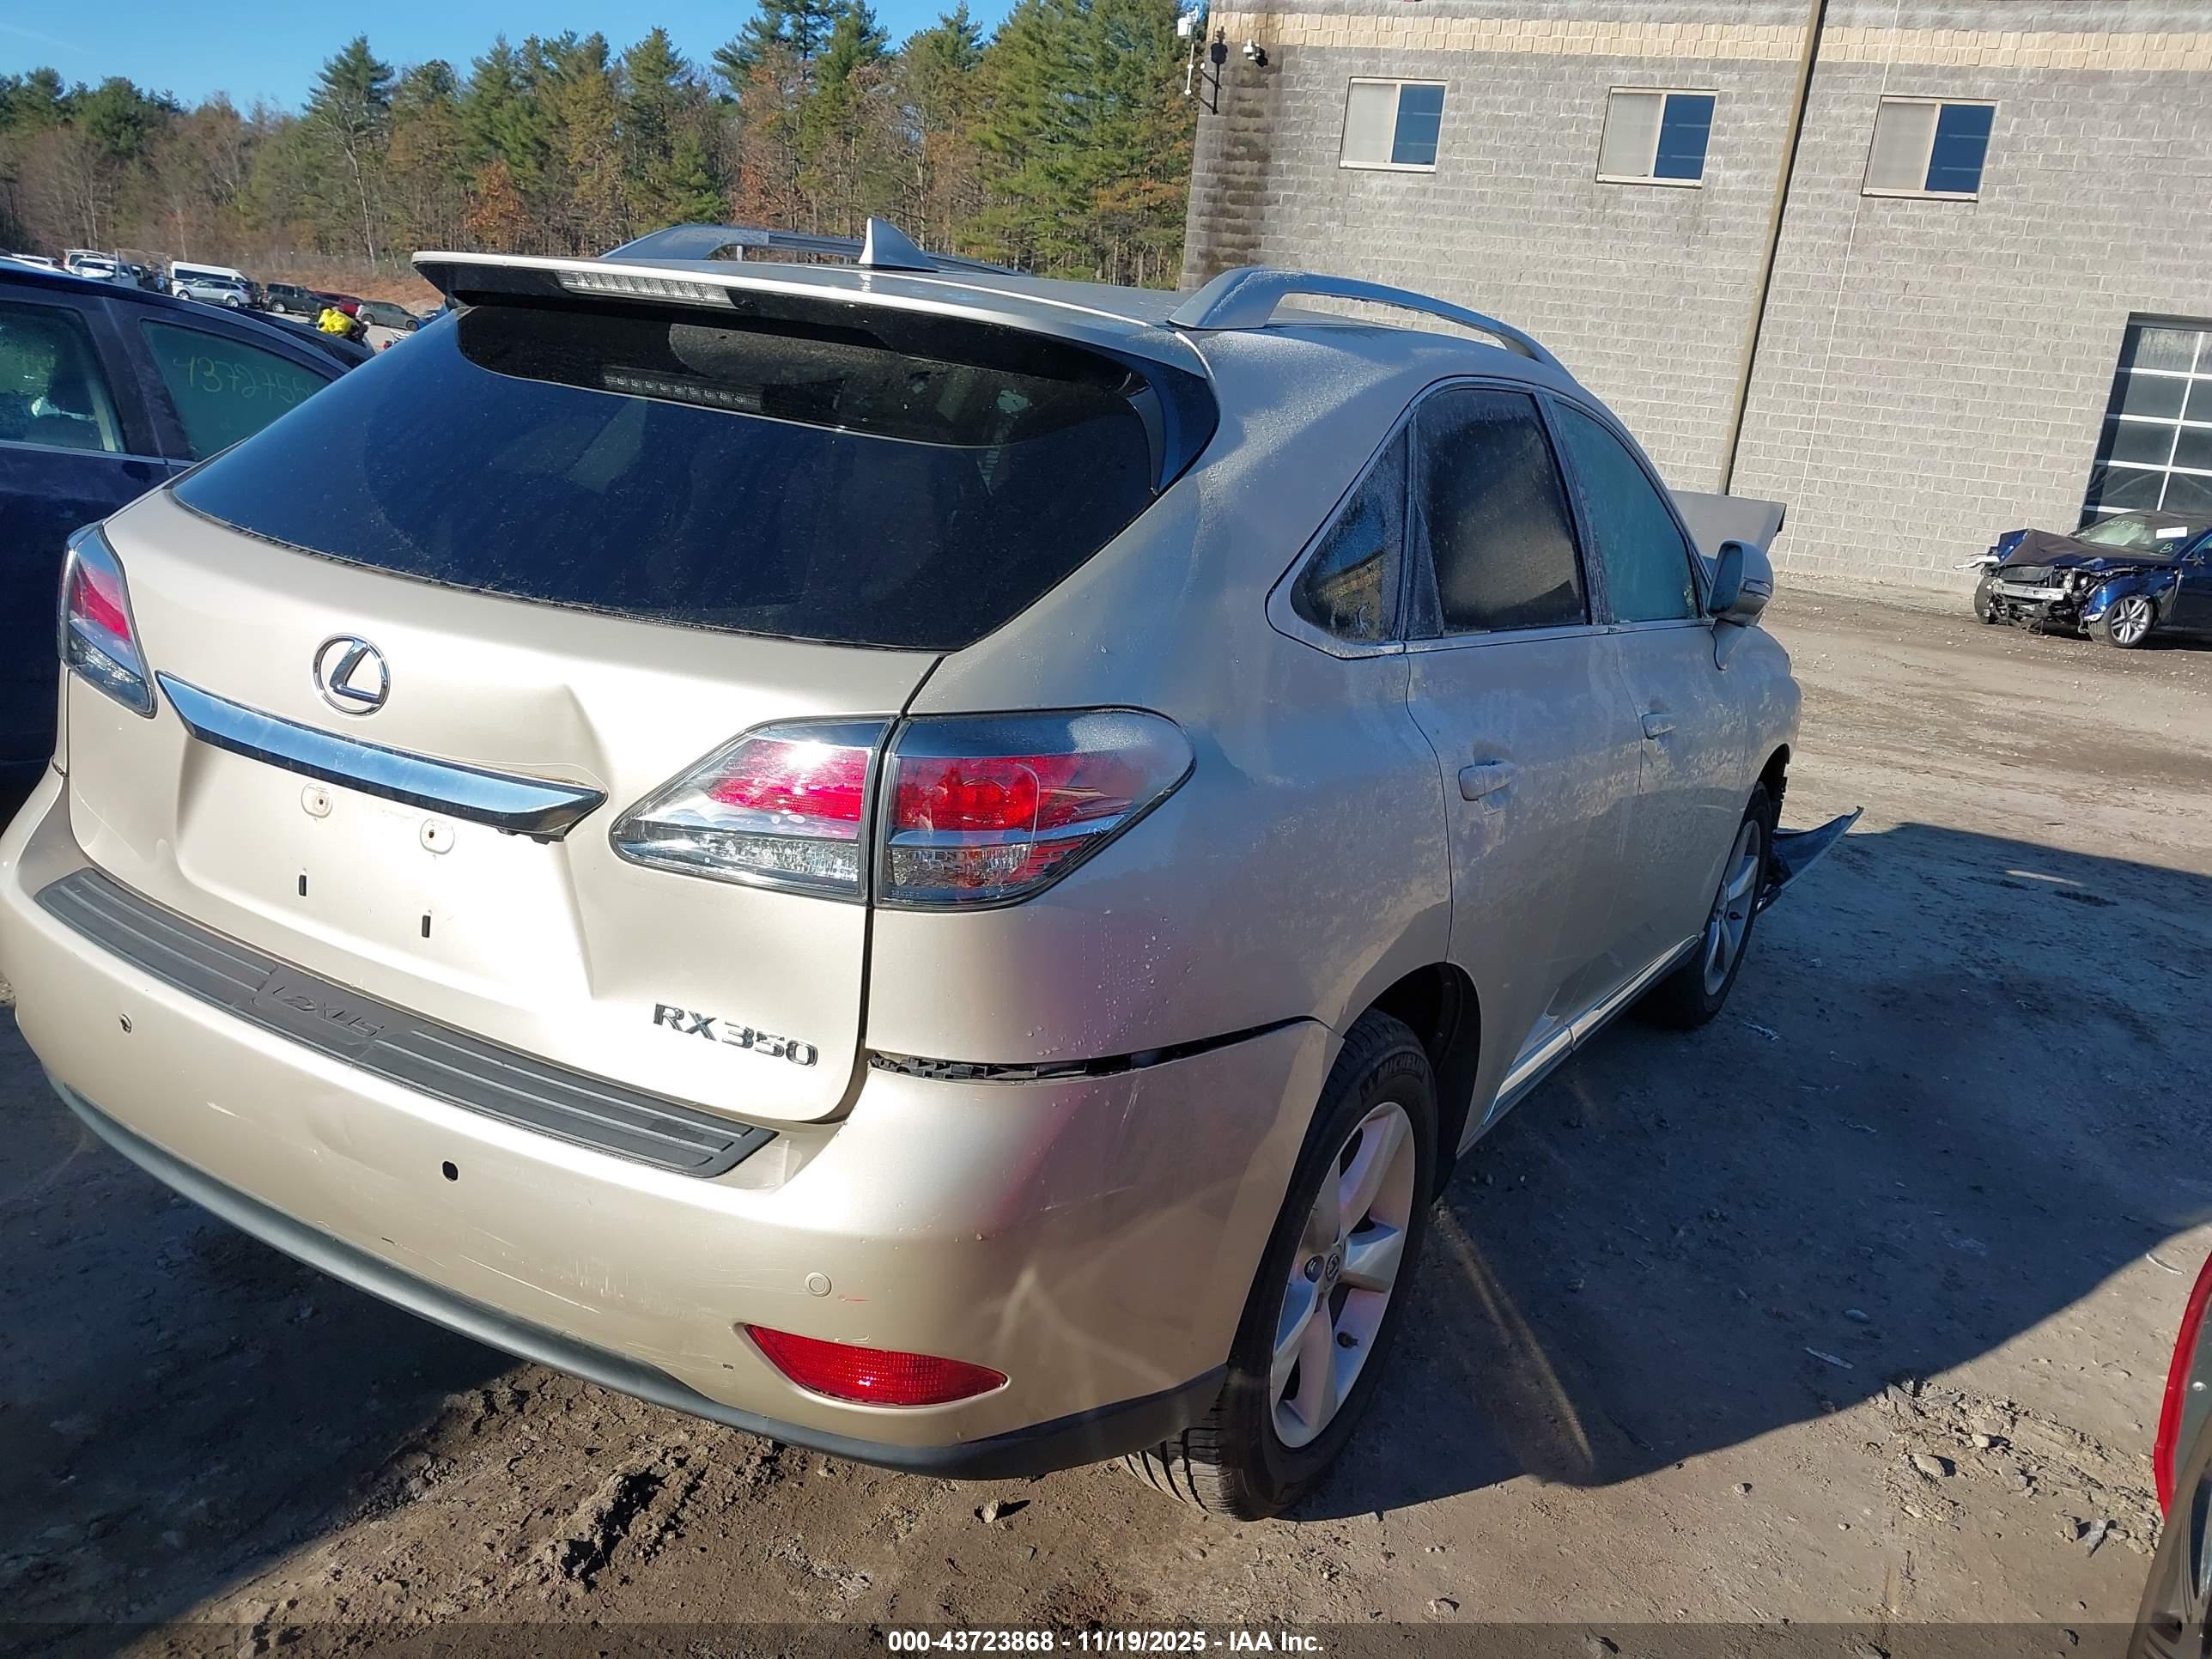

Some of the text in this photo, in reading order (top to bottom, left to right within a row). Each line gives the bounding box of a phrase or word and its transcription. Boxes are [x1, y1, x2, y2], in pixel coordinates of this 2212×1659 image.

[270, 985, 386, 1037] LEXUS
[653, 1002, 819, 1067] RX 350
